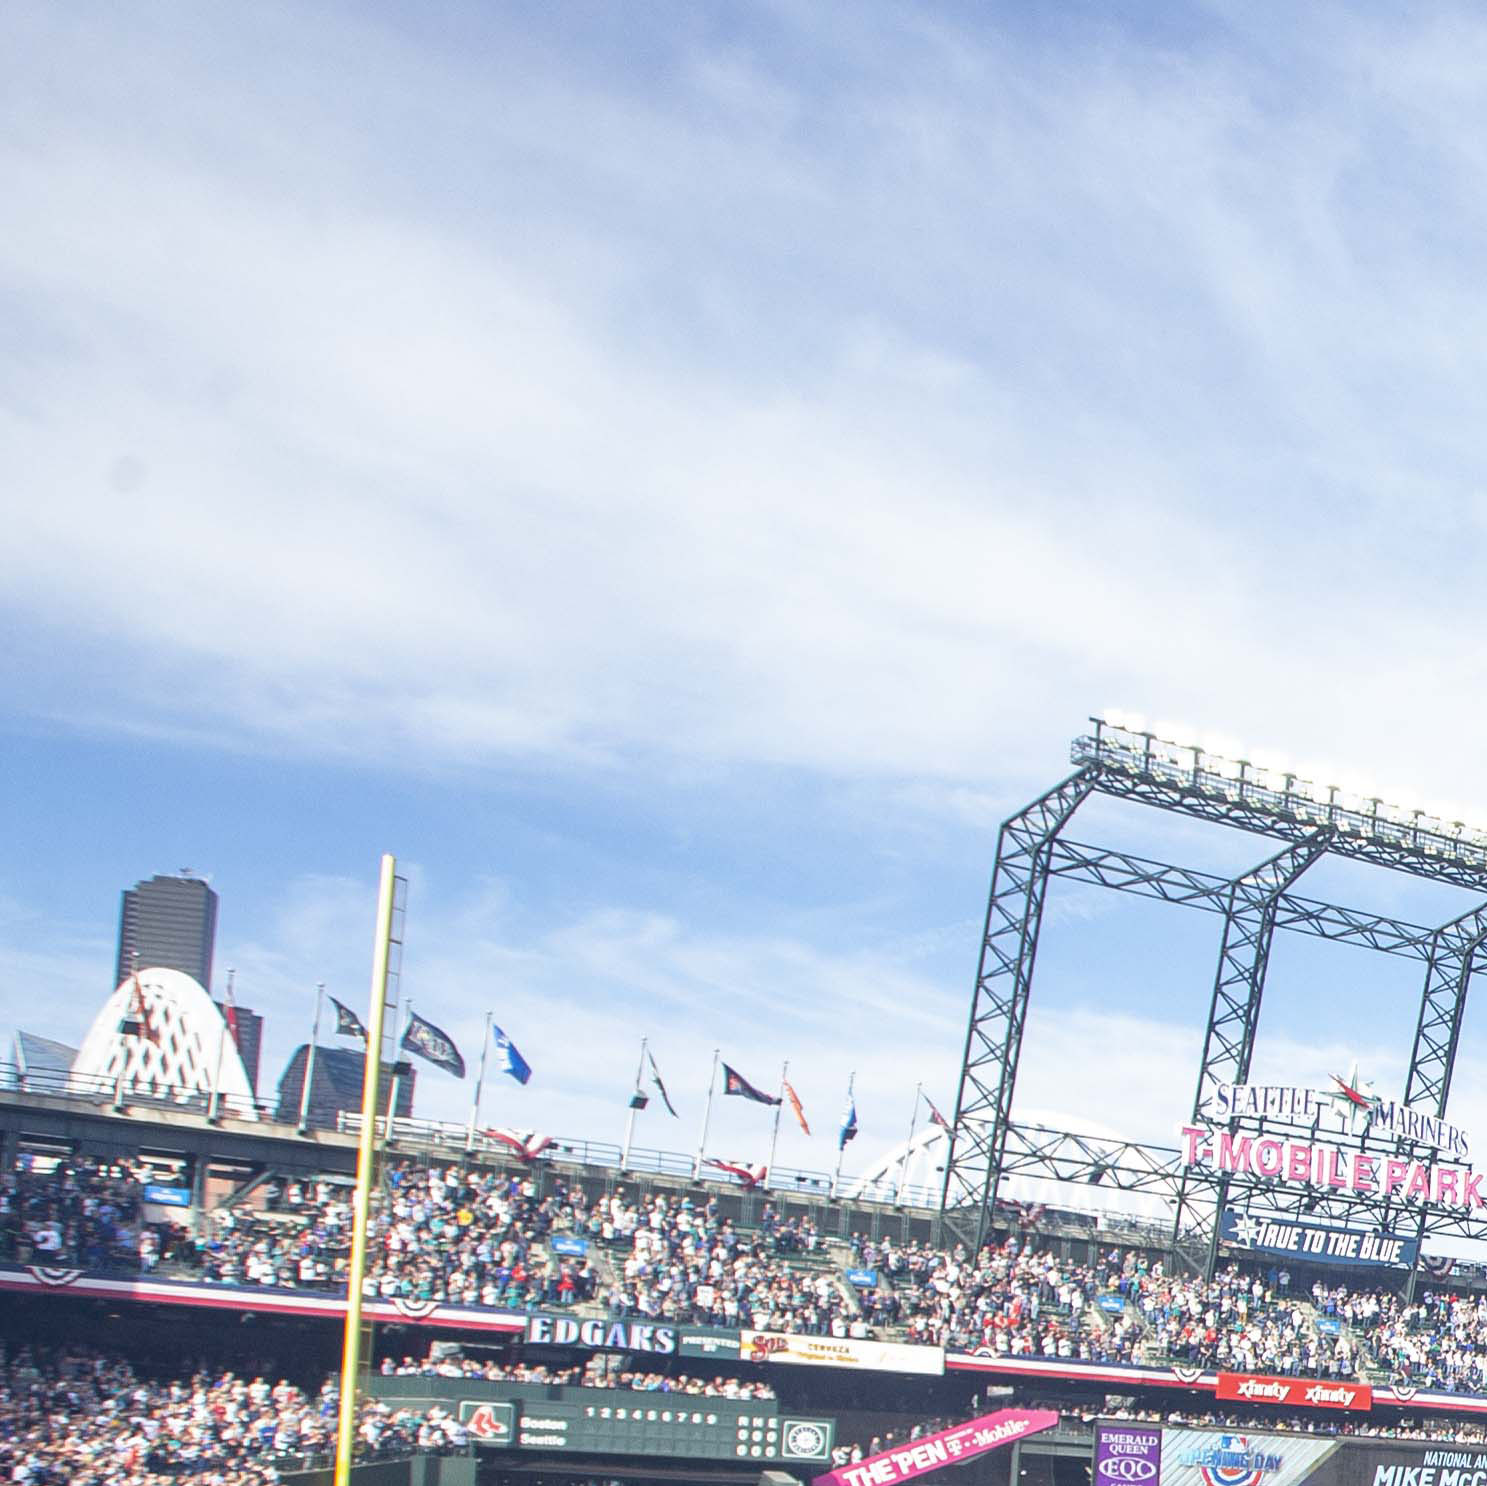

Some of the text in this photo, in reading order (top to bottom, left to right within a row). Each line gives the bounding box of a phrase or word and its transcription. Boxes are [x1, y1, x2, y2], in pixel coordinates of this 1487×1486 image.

[1216, 1083, 1471, 1158] SEATTLE MARINERS
[1181, 1125, 1486, 1209] T-MOBILE PARK
[1256, 1219, 1404, 1263] TRUE TO THE BLUE
[682, 1336, 739, 1349] PRESENTED
[1237, 1380, 1356, 1406] xfinity xfinity
[520, 1416, 568, 1430] Boston
[520, 1433, 567, 1446] Seattle
[1101, 1432, 1158, 1446] EMERALD
[1109, 1443, 1149, 1455] QUEEN
[1106, 1459, 1150, 1479] EQC
[1178, 1448, 1282, 1473] OPENING DAY
[1423, 1451, 1472, 1469] NATIONAL
